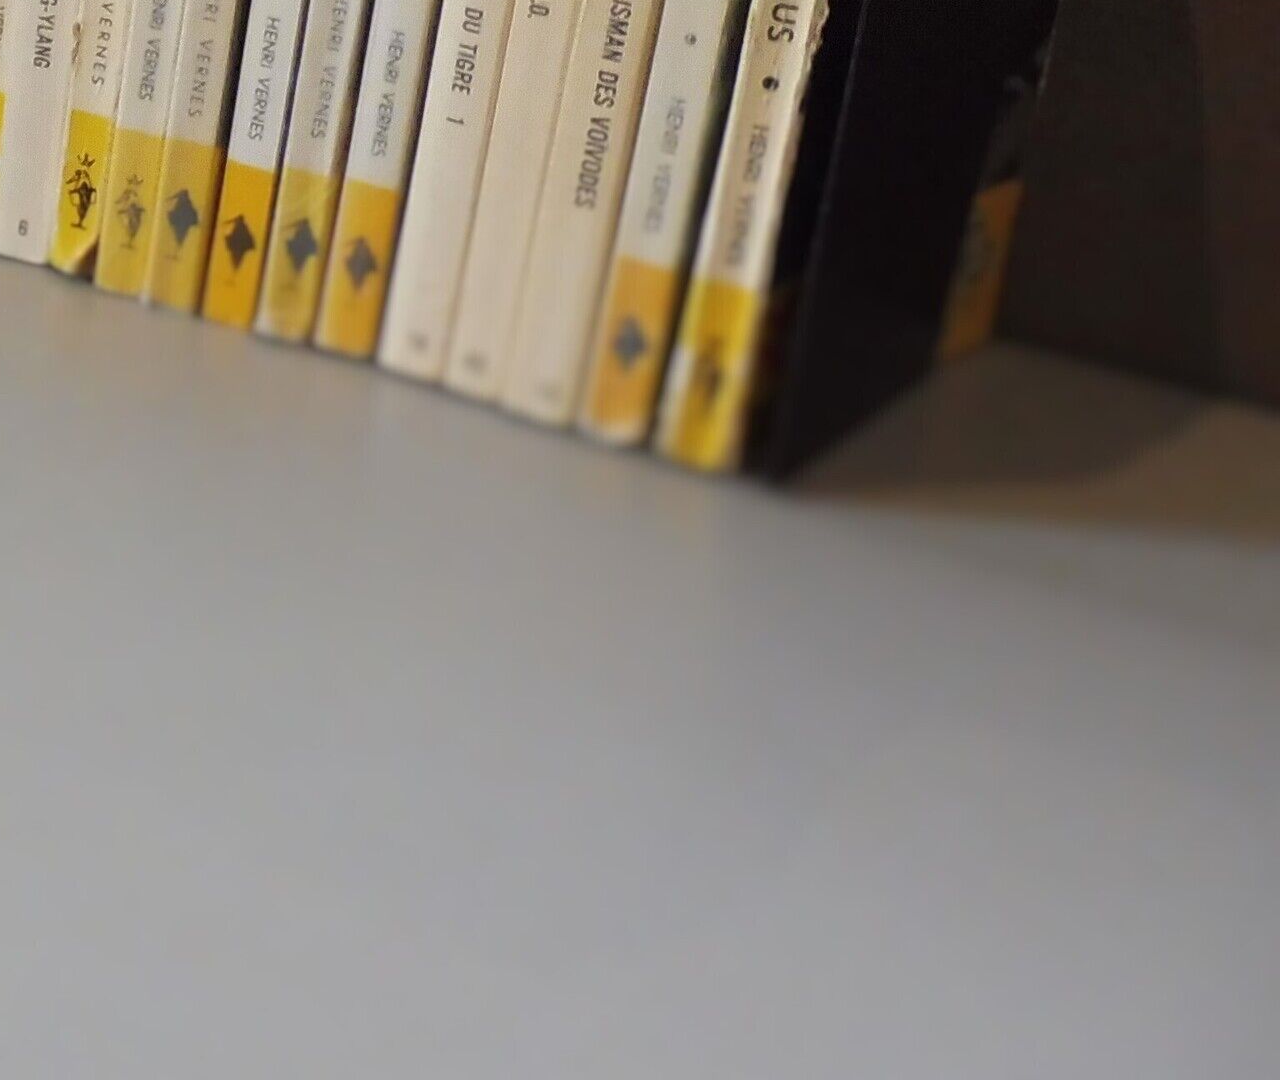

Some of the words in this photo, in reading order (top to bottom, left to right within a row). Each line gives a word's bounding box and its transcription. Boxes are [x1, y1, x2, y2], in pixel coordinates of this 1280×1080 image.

[90, 2, 115, 88] VERNES
[264, 16, 282, 72] HENRI
[459, 5, 485, 36] DU
[138, 35, 164, 102] VERNES
[382, 29, 406, 87] HENRI
[449, 39, 481, 98] TIGRE
[246, 77, 276, 143] VERNES
[592, 65, 622, 111] DES
[369, 90, 397, 159] VERNES
